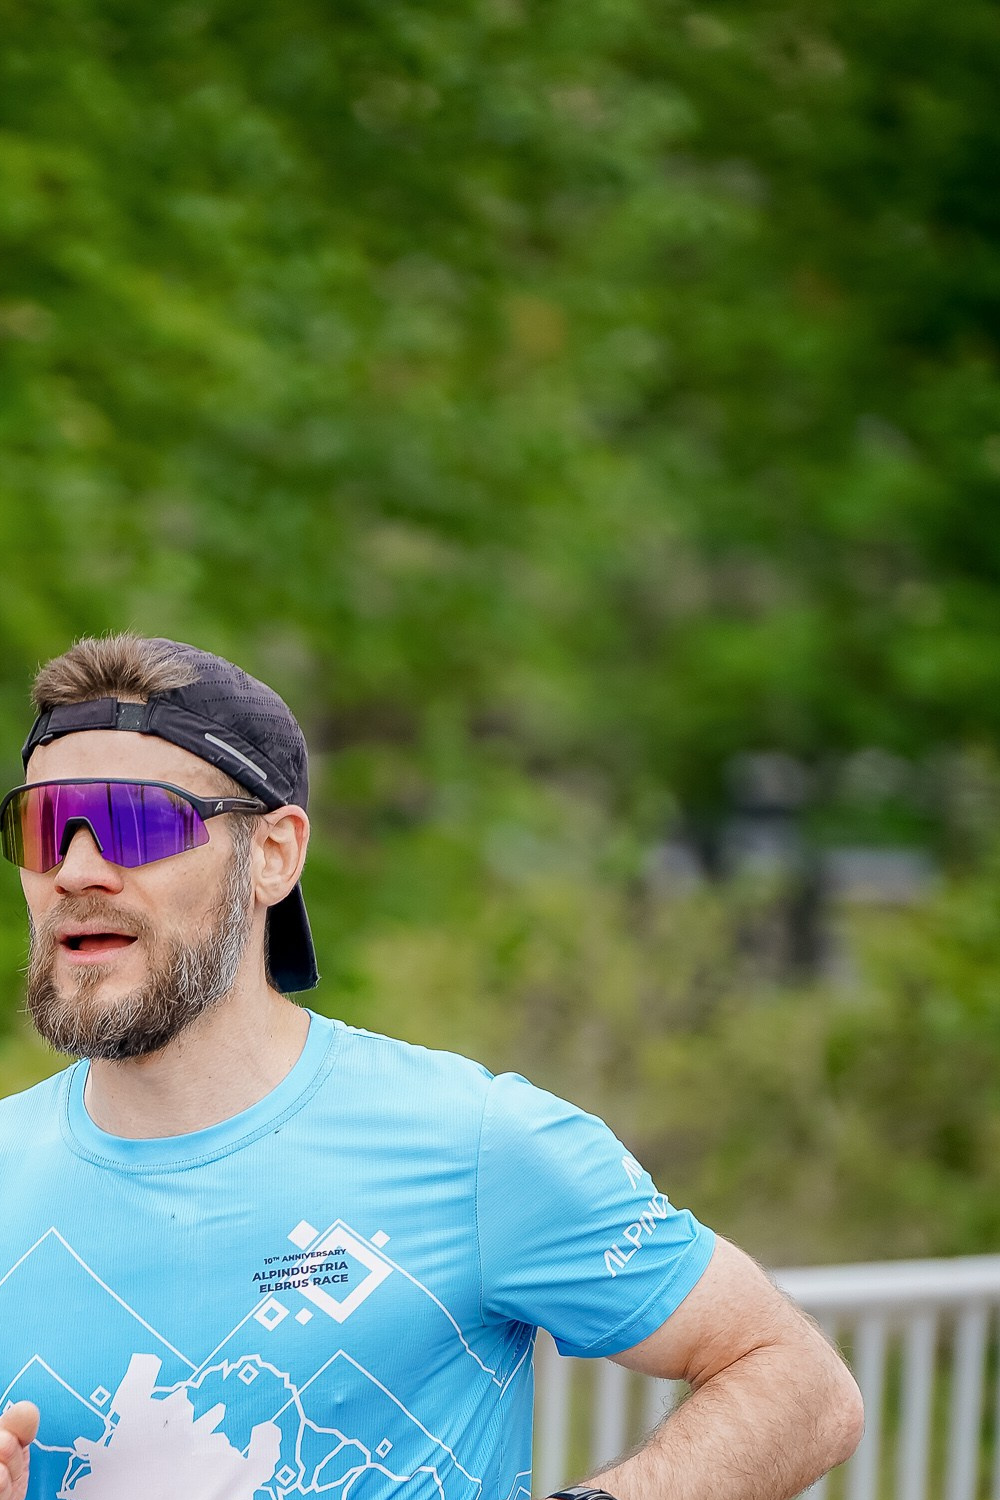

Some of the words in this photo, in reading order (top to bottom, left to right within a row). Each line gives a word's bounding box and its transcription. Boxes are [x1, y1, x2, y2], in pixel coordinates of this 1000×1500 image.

[263, 1256, 280, 1265] 10TH
[282, 1248, 347, 1263] ANNIVERSARY
[252, 1261, 349, 1282] ALPINDUSTRIA
[259, 1278, 309, 1294] ELBRUS
[313, 1273, 349, 1287] RACE
